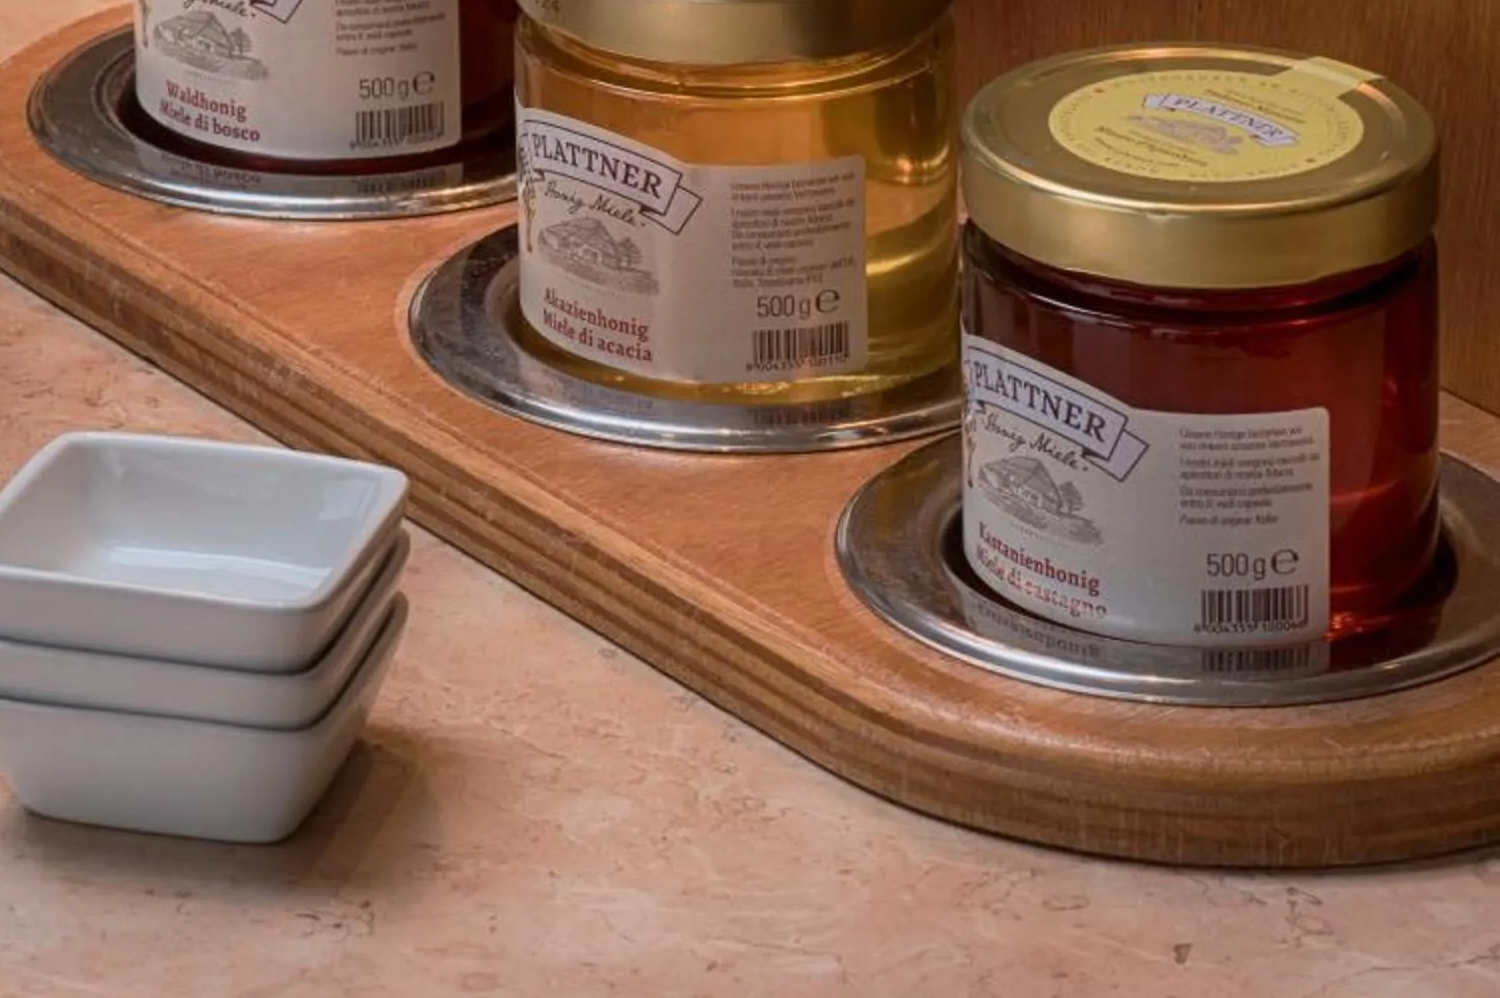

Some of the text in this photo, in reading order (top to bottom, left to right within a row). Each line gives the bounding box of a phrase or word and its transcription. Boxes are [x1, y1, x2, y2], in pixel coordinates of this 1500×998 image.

[159, 98, 261, 143] Miele di bosco
[165, 79, 248, 122] Waldhonig
[1173, 96, 1285, 138] PLATTNER
[532, 132, 662, 200] PLATTNER
[543, 287, 650, 342] Akazienhonig
[579, 327, 594, 347] di
[597, 337, 653, 363] acacia
[973, 360, 1106, 443] PLATTNER
[979, 520, 1100, 597] Kastanienhonig
